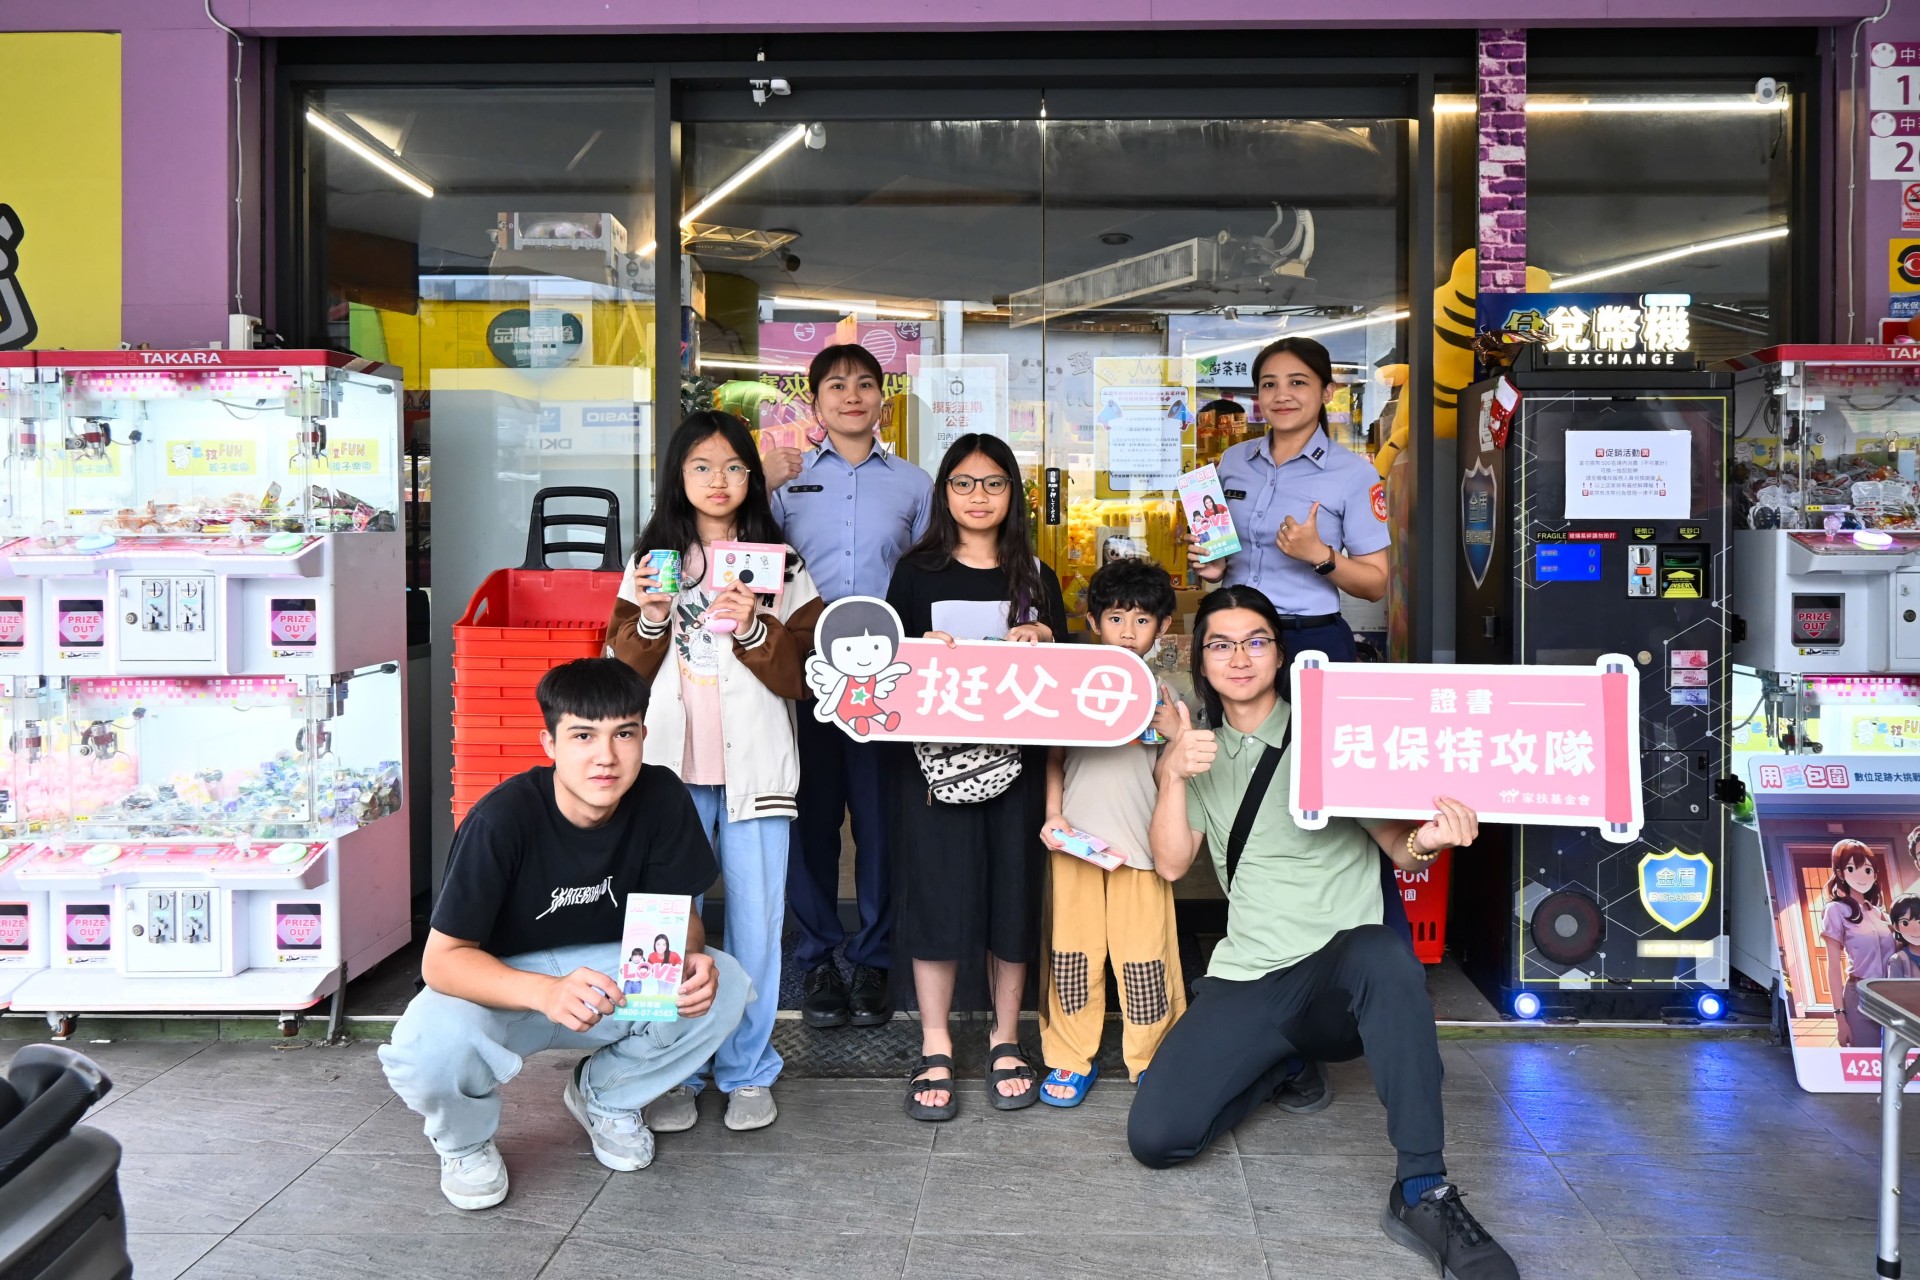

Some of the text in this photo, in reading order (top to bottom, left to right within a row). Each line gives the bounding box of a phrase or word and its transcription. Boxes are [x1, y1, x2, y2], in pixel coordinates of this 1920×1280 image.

[140, 352, 222, 364] TAKARA
[1568, 353, 1675, 365] EXCHANGE
[1192, 513, 1230, 535] LOVE
[1634, 527, 1655, 535] 硬幣口
[1679, 527, 1700, 535] 紙鈔口
[280, 615, 312, 623] PRIZE
[1798, 612, 1831, 621] PRIZE
[72, 625, 95, 633] OUT
[284, 624, 307, 632] OUT
[1803, 622, 1826, 630] OUT
[915, 656, 1139, 728] 挺父母
[1429, 687, 1494, 715] 證書
[1331, 724, 1596, 777] 兒保特攻隊
[1759, 765, 1849, 790] 用愛包圍
[1522, 791, 1591, 807] 家扶基金會
[1656, 867, 1696, 887] 金盾
[1649, 892, 1703, 902] EXCHANGE
[75, 919, 106, 927] PRIZE
[80, 928, 102, 936] OUT
[290, 928, 312, 936] OUT
[622, 961, 681, 984] LOVE
